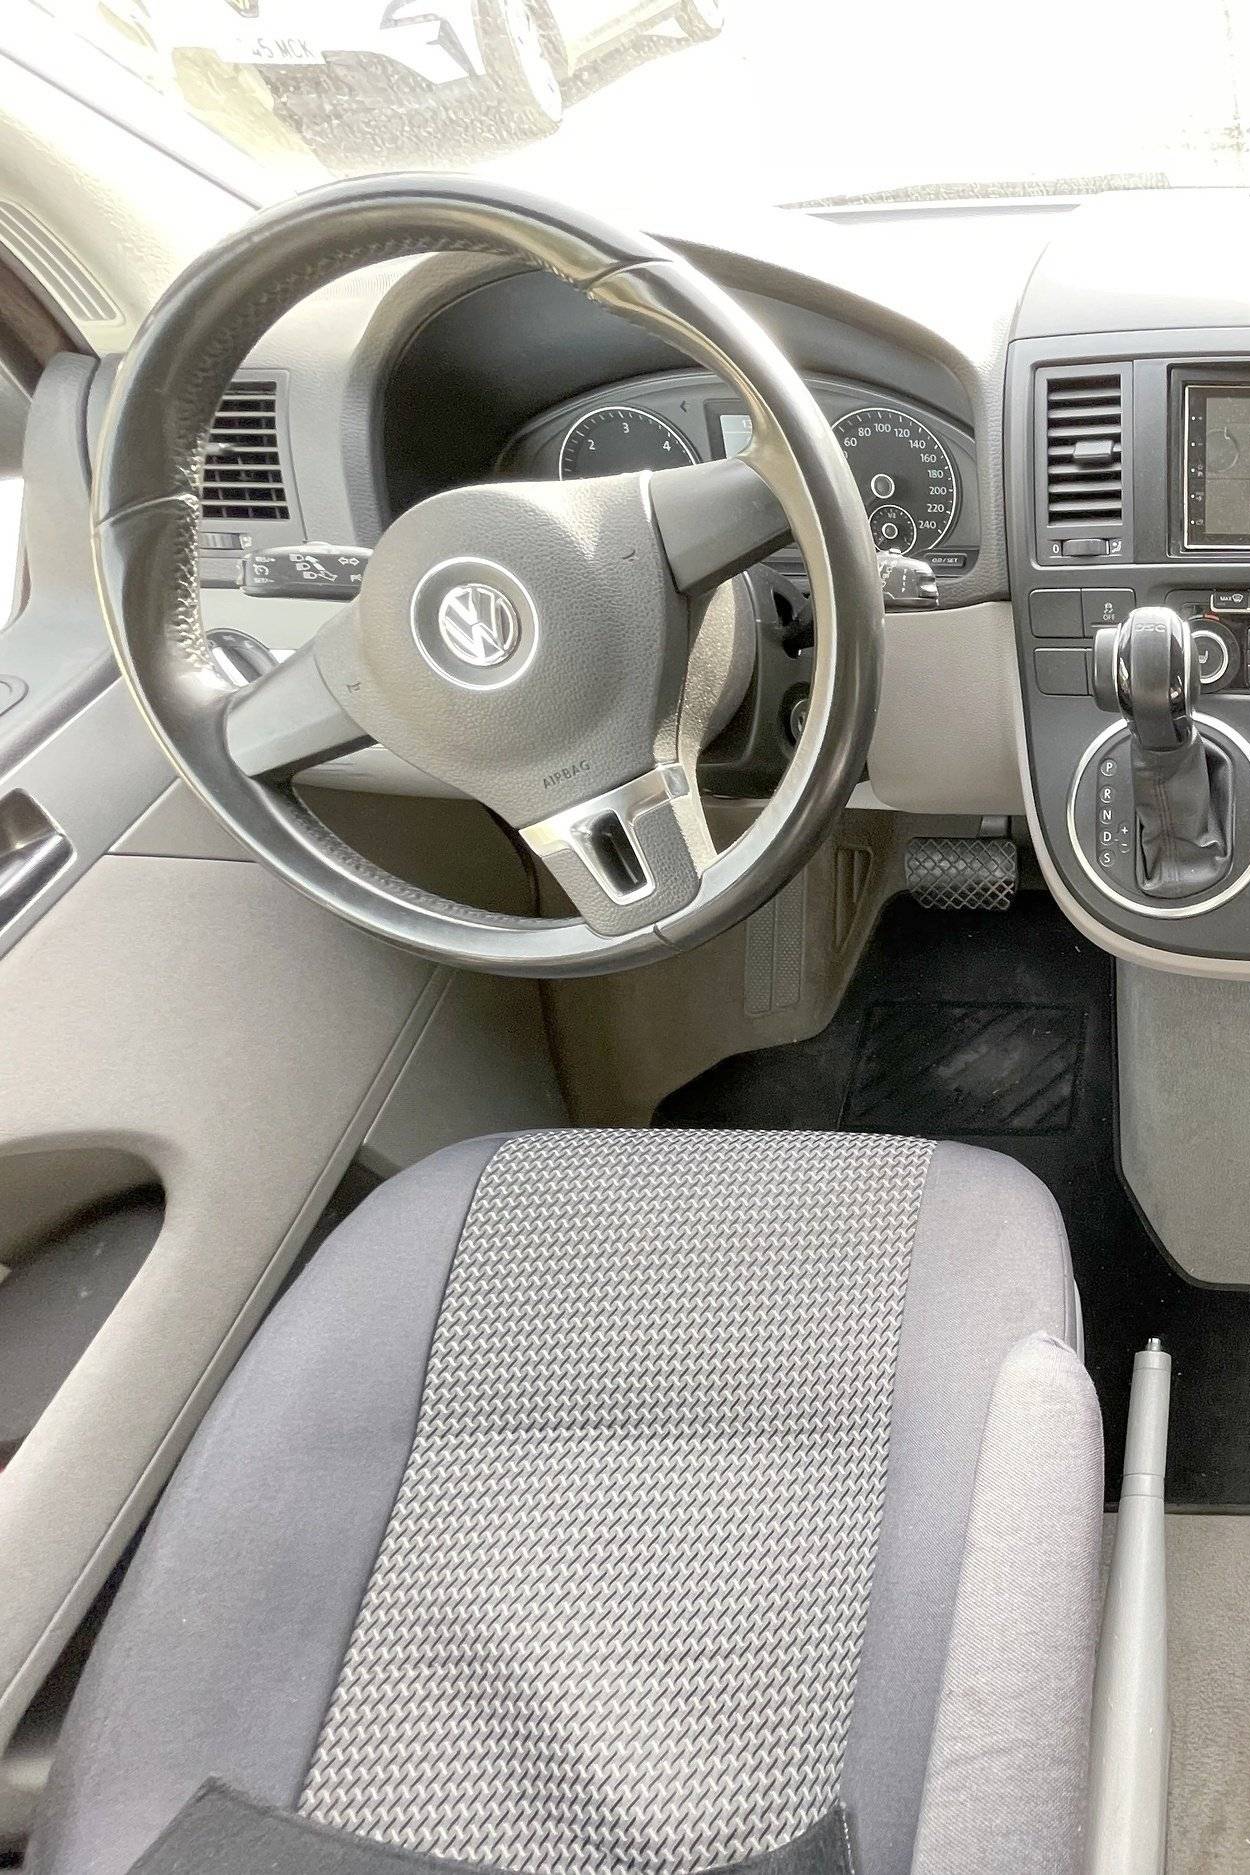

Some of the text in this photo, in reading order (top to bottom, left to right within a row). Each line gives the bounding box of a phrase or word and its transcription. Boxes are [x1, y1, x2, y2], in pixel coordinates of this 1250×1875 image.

[622, 422, 630, 433] 3
[858, 427, 872, 437] 80
[874, 423, 891, 433] 100
[894, 428, 911, 438] 120
[587, 439, 596, 450] 2
[662, 440, 671, 451] 4
[843, 437, 858, 447] 60
[909, 440, 926, 449] 140
[920, 453, 937, 463] 160
[928, 469, 944, 479] 180
[929, 486, 947, 495] 200
[926, 503, 945, 513] 220
[919, 520, 937, 529] 240
[542, 759, 591, 790] AIRBAG
[1103, 809, 1112, 820] N
[1103, 831, 1112, 842] D
